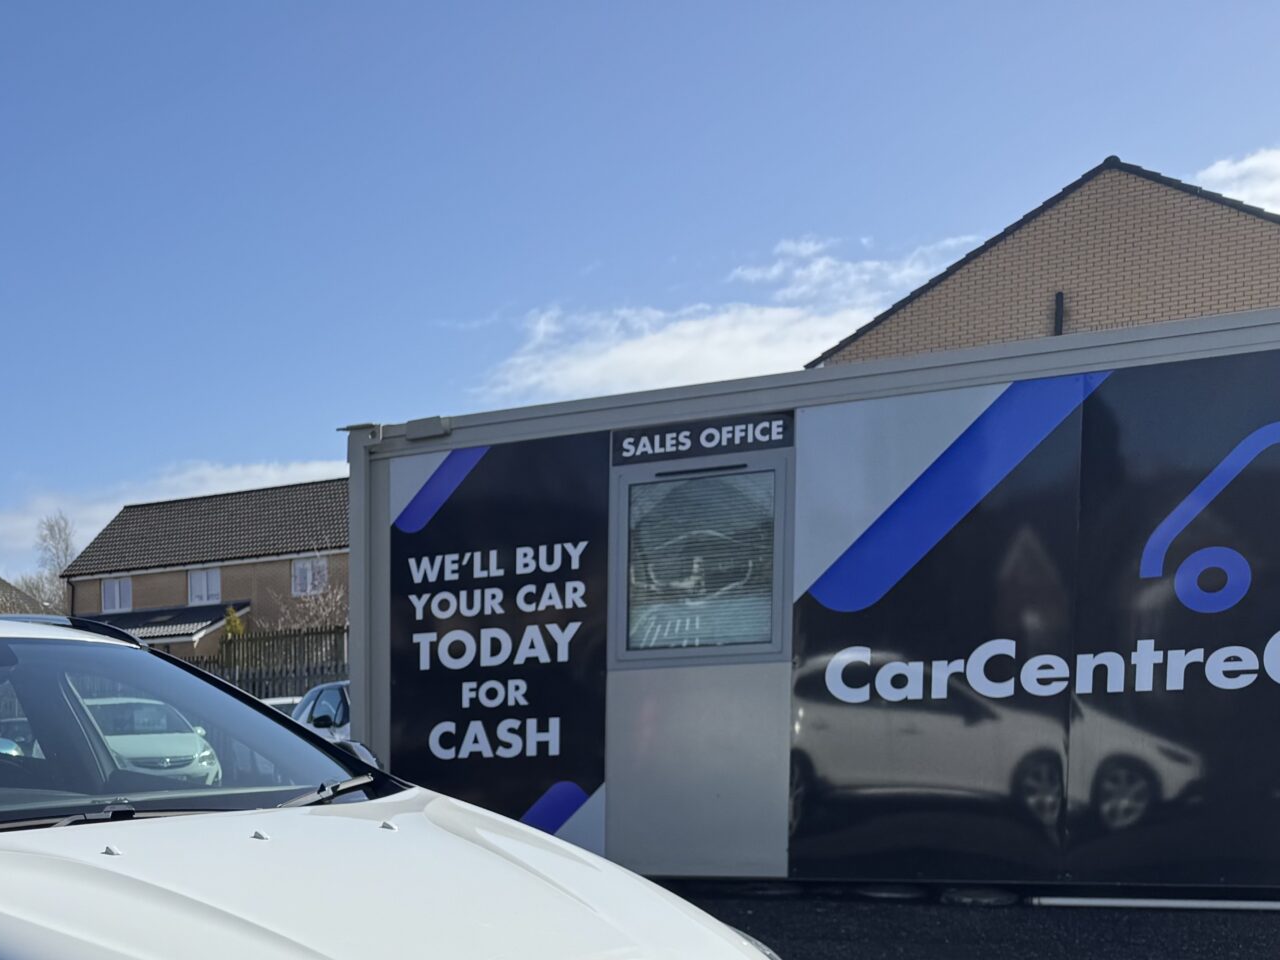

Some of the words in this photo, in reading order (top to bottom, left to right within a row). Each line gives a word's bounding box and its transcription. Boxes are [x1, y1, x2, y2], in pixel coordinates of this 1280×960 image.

[622, 431, 691, 457] SALES
[699, 420, 783, 448] OFFICE
[408, 550, 504, 584] WE'LL
[516, 541, 589, 575] BUY
[408, 587, 505, 620] YOUR
[516, 581, 587, 613] CAR
[412, 621, 582, 671] TODAY
[462, 679, 529, 708] FOR
[428, 717, 560, 760] CASH
